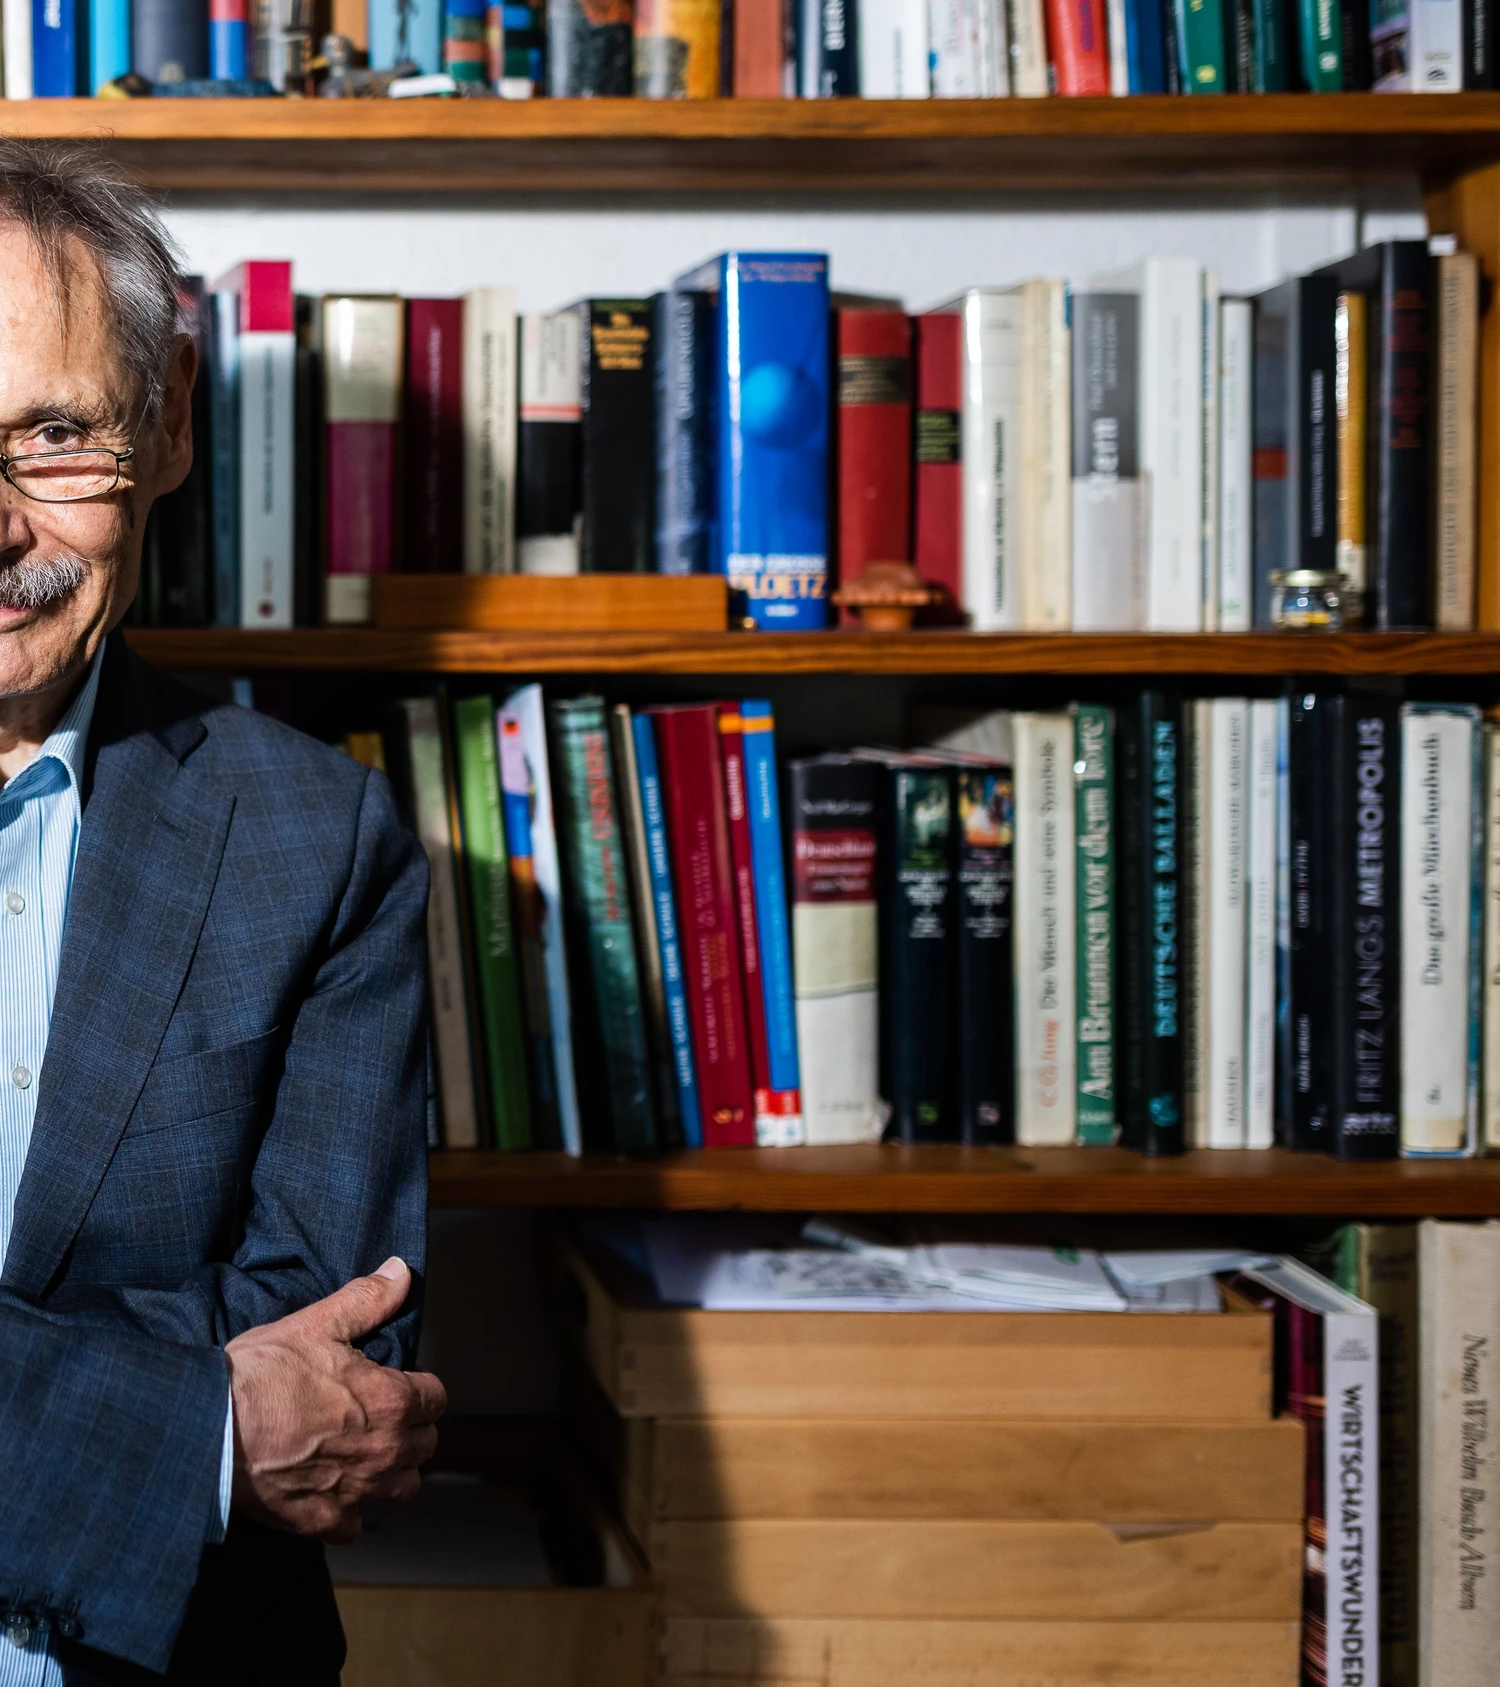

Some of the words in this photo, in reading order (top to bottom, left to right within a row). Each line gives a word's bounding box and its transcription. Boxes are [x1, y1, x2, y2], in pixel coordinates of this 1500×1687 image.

[1079, 788, 1109, 857] dem
[1152, 720, 1176, 873] BALLADEN
[1355, 718, 1385, 907] METROPOLIS
[1086, 862, 1108, 907] vor
[1080, 910, 1111, 1042] Brunnen
[1153, 882, 1178, 1038] DEUTSCHE
[1355, 914, 1384, 1019] LANGS
[1080, 1046, 1112, 1098] Am
[1354, 1028, 1384, 1103] FRITZ
[1460, 1333, 1487, 1394] Neues
[1459, 1399, 1487, 1481] Wilhelm
[1340, 1384, 1365, 1687] WIRTSCHAFTSWUNDER
[1459, 1487, 1487, 1541] Busch
[1458, 1543, 1487, 1611] Album
